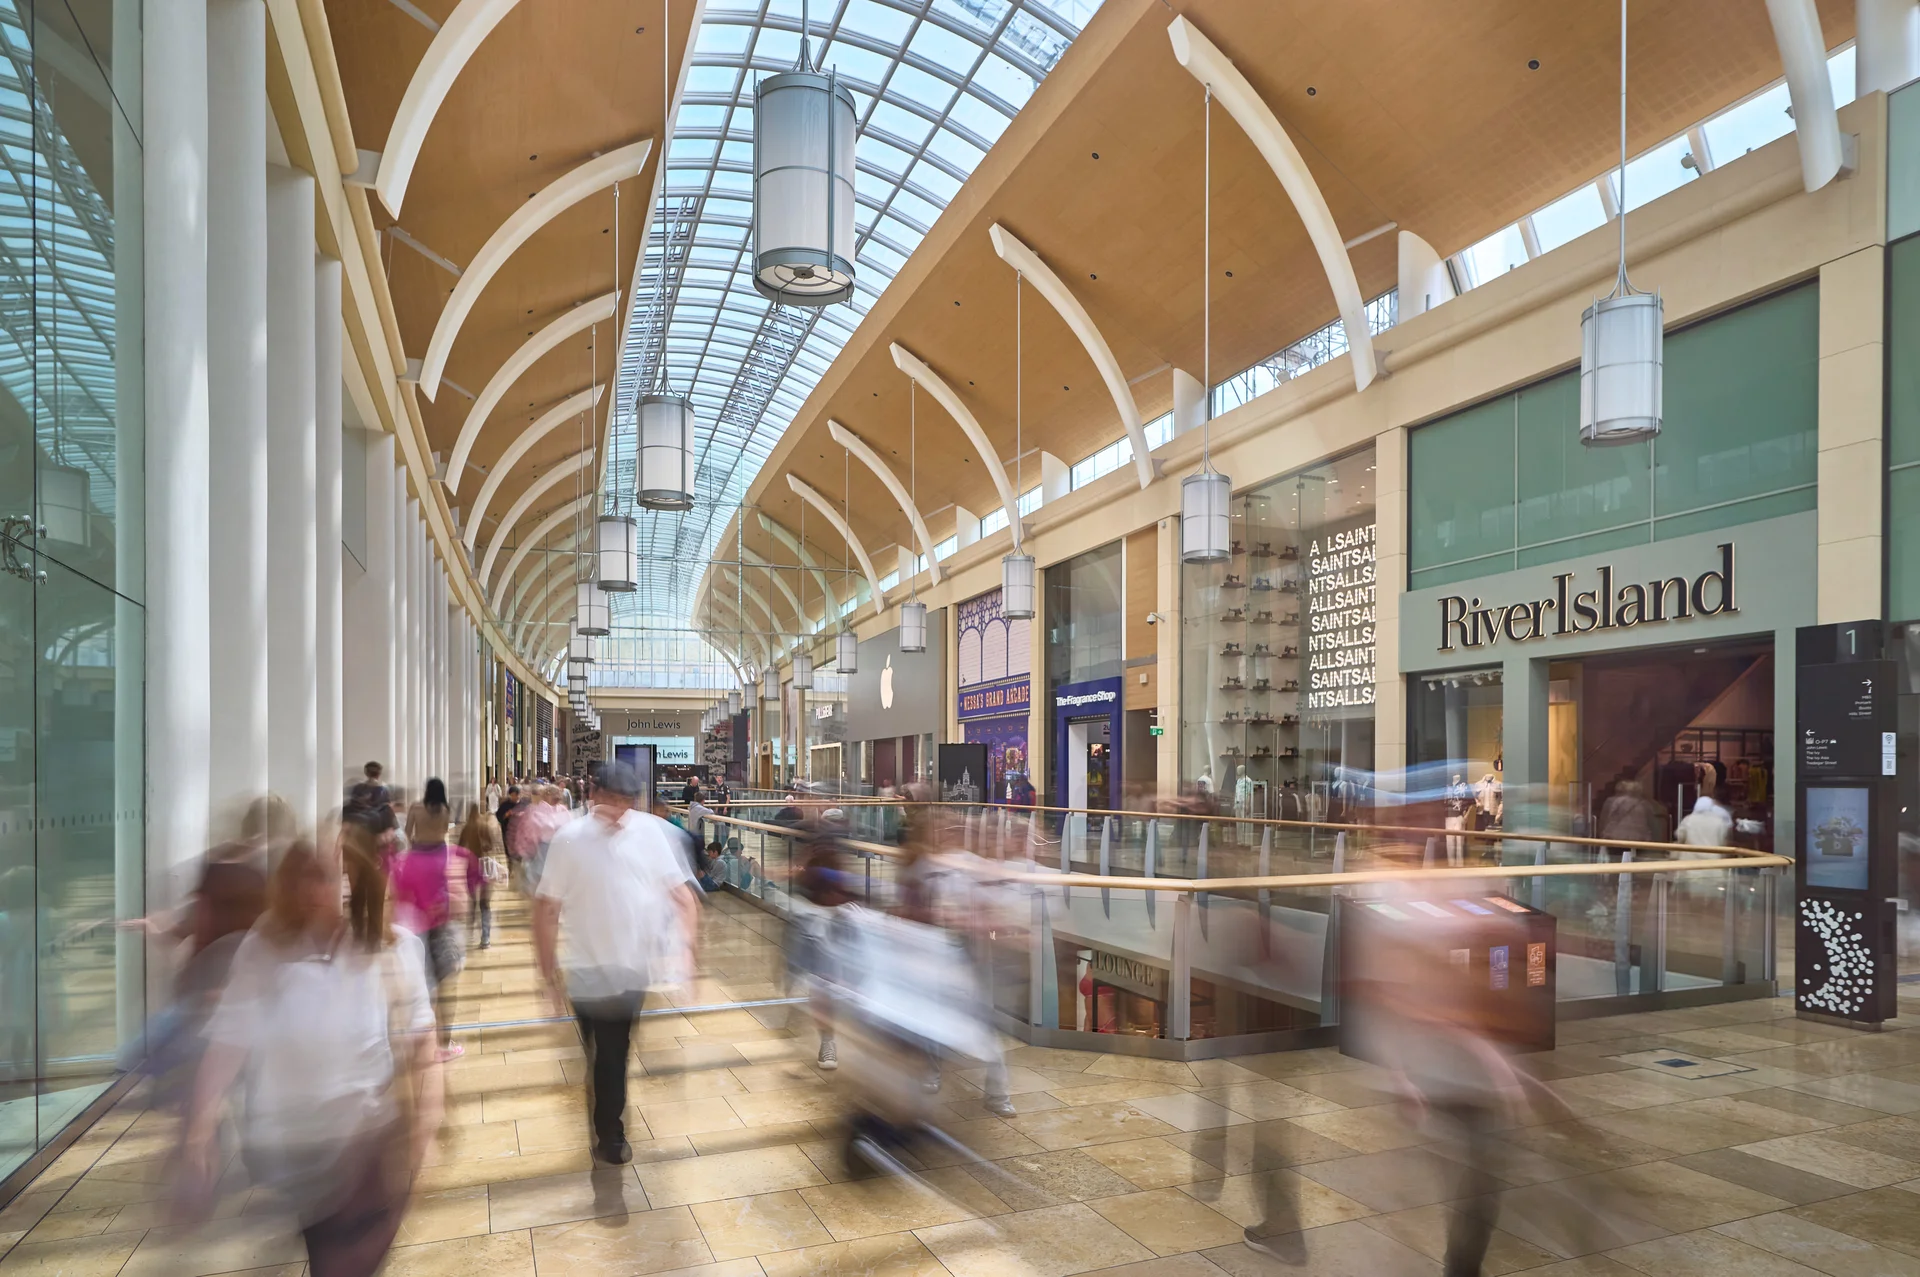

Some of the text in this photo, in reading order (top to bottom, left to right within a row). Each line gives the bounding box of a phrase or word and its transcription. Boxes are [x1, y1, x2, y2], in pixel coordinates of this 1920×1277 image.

[1846, 629, 1856, 655] 1
[985, 689, 1004, 708] GRAND
[1006, 685, 1029, 704] ARCADE
[1097, 690, 1116, 703] Shop
[627, 719, 681, 731] John Lewis
[662, 749, 688, 759] Lewis
[1096, 951, 1155, 987] LOUNGE
